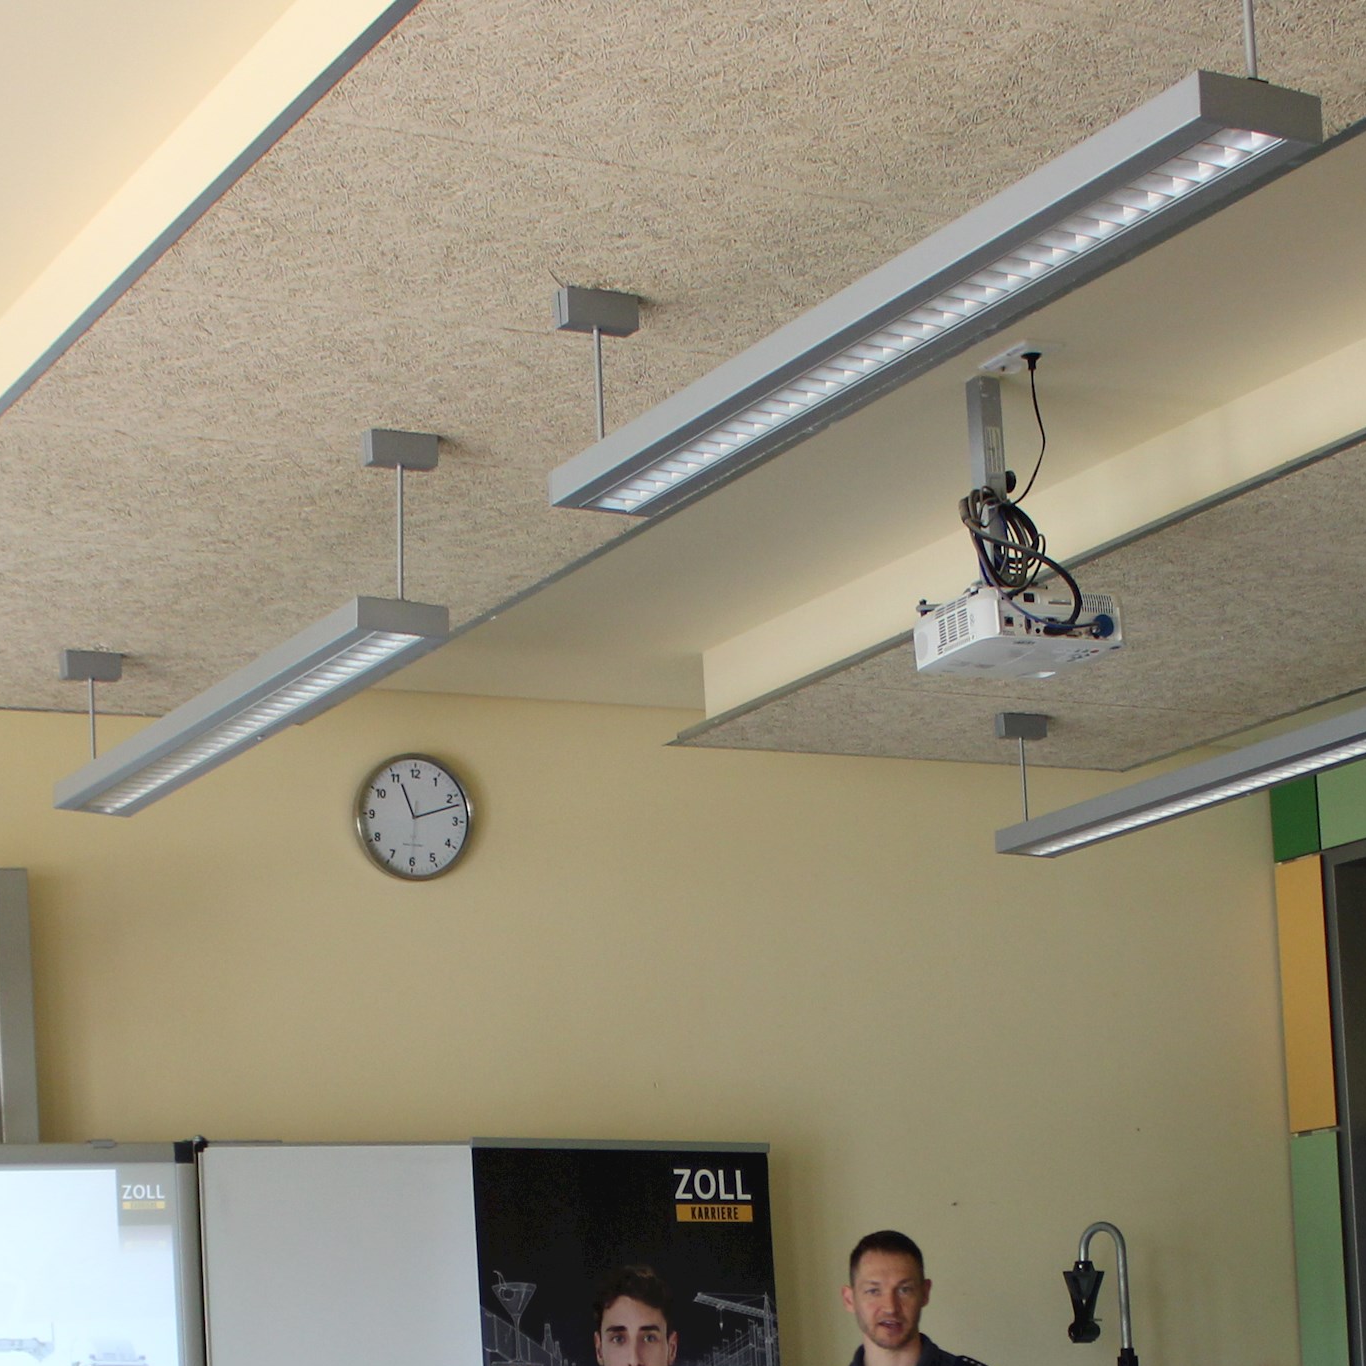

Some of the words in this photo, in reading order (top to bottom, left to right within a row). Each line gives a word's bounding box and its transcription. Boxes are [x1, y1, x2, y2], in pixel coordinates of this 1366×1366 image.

[391, 774, 400, 783] 11
[410, 769, 421, 779] 12
[433, 777, 437, 787] 1
[376, 789, 386, 799] 10
[446, 794, 453, 803] 2
[368, 809, 375, 819] 9
[452, 817, 459, 826] 3
[374, 832, 381, 841] 8
[444, 838, 451, 848] 4
[389, 849, 396, 858] 7
[429, 853, 436, 862] 5
[409, 857, 415, 866] 6
[673, 1168, 752, 1200] ZOLL
[121, 1184, 165, 1199] ZOLL
[691, 1206, 739, 1220] KARRIERE
